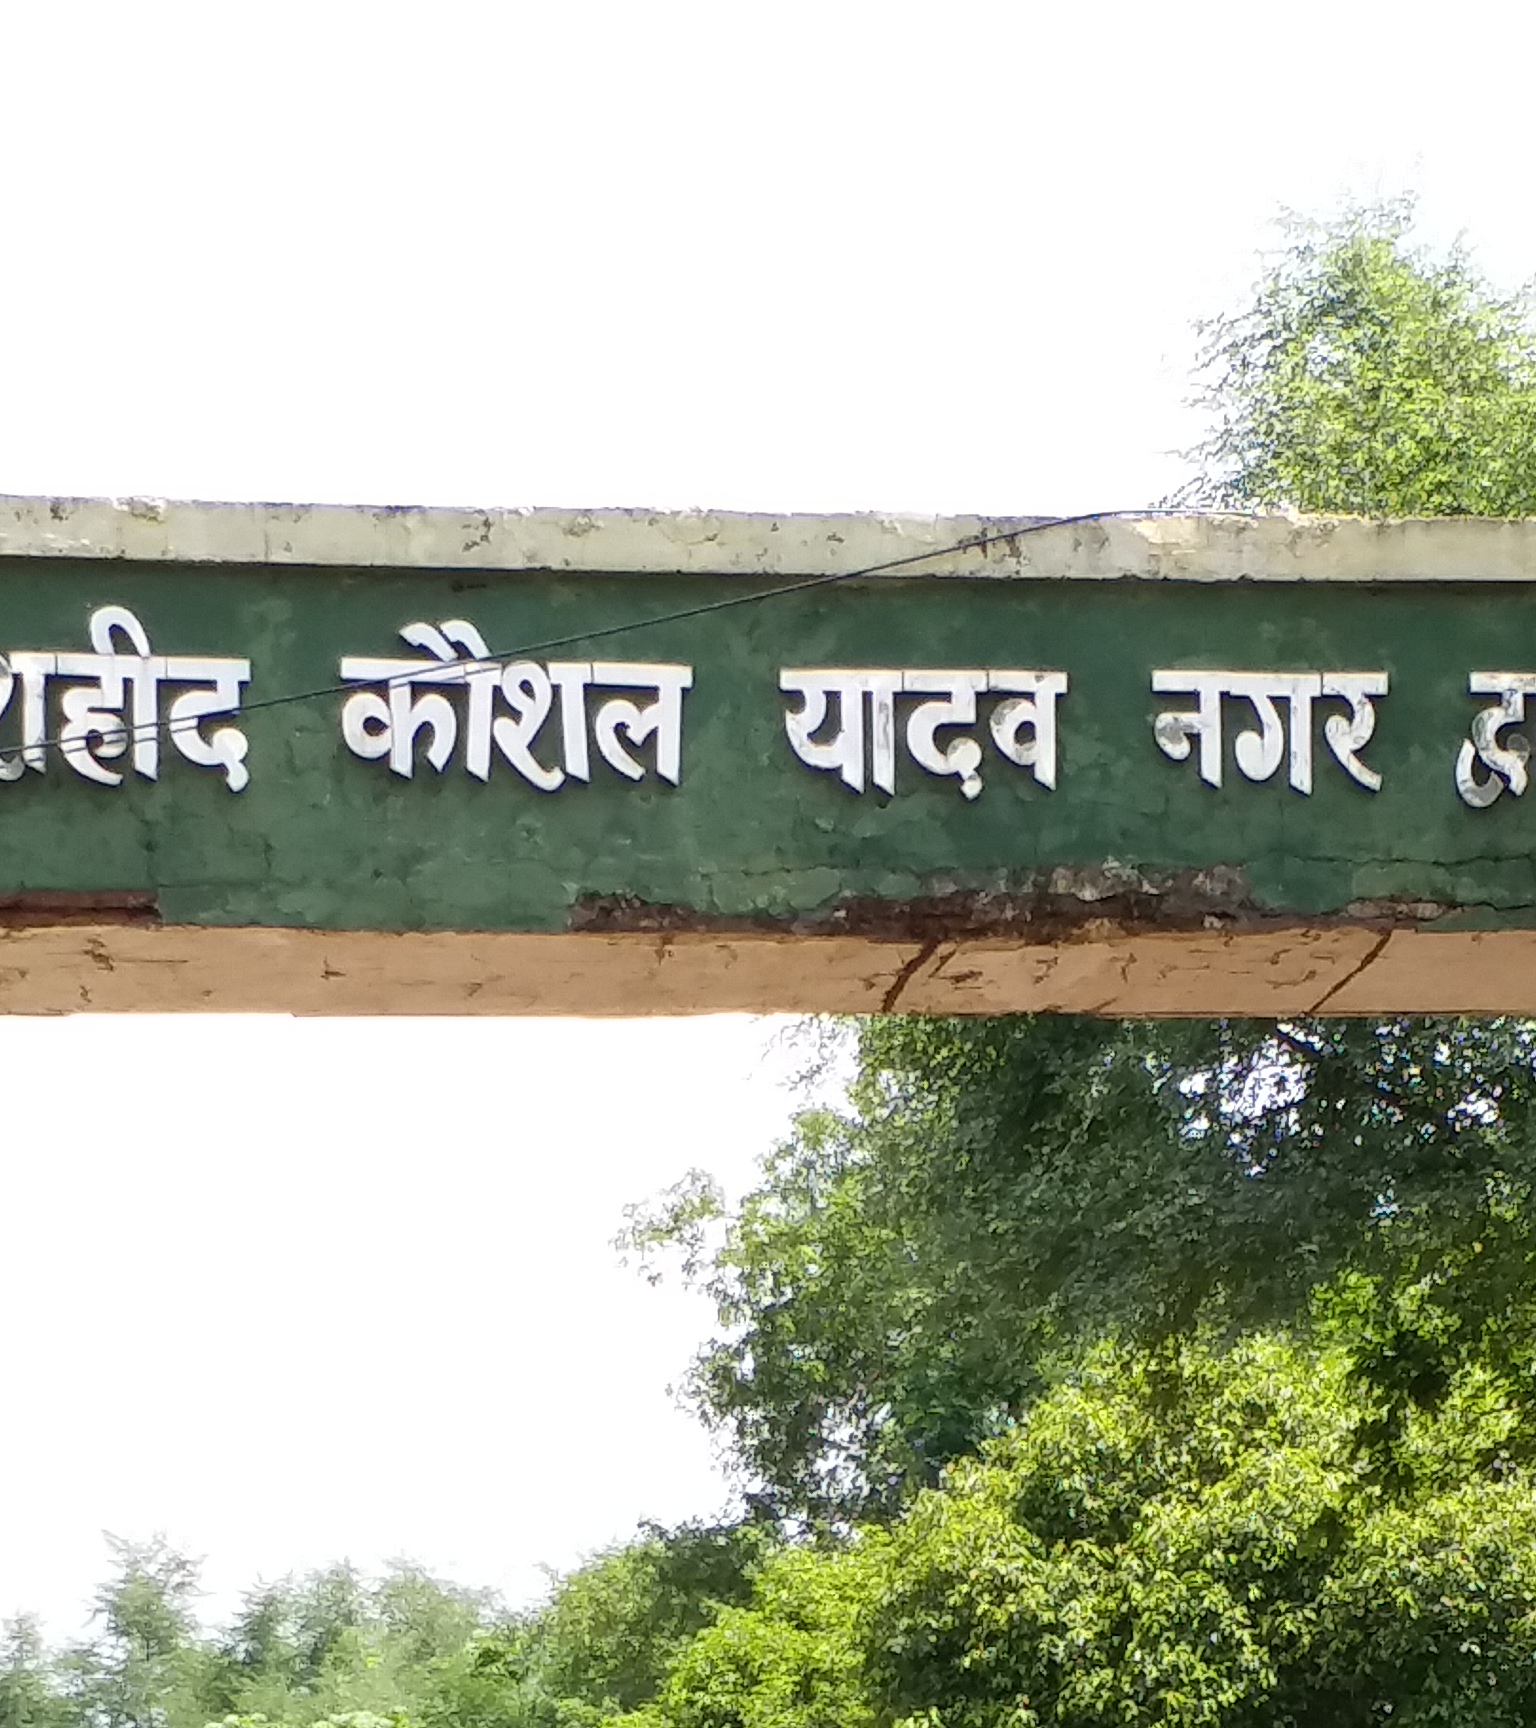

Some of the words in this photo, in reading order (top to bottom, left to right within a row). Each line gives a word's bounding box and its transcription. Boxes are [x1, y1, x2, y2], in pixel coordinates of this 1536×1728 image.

[337, 618, 695, 791] कौशल
[779, 667, 1069, 800] यादव
[1151, 668, 1390, 796] नगर
